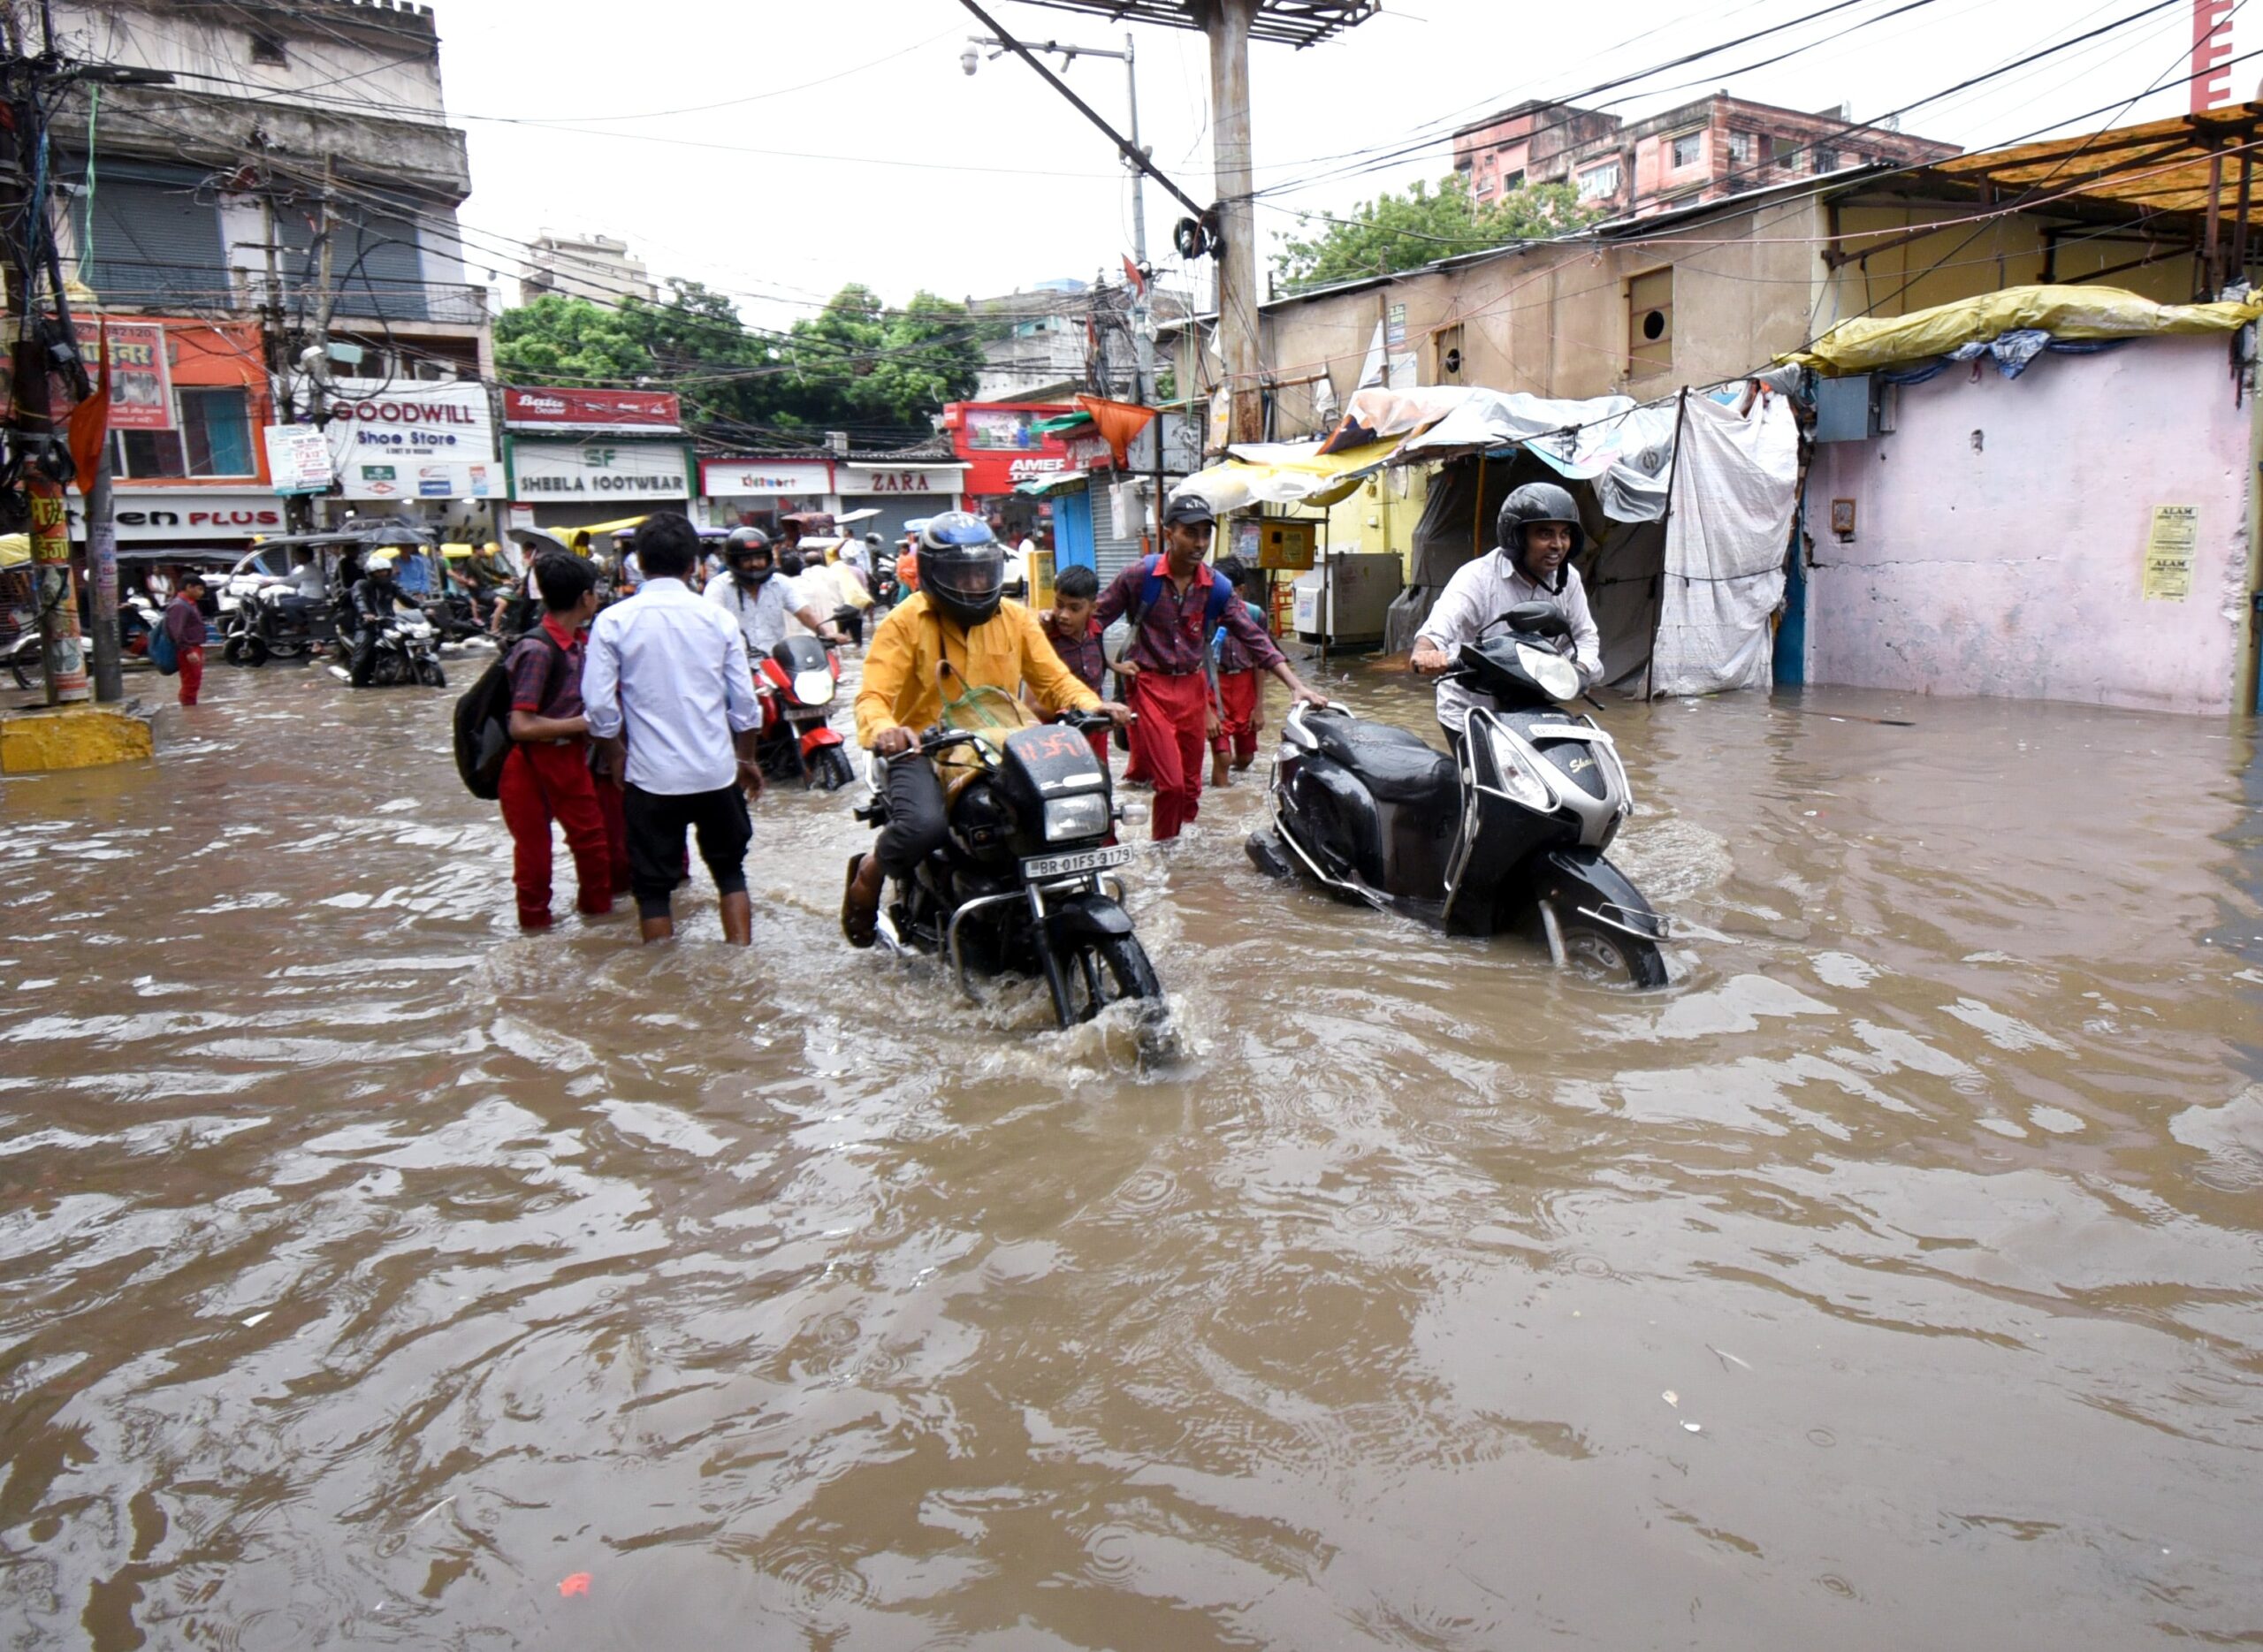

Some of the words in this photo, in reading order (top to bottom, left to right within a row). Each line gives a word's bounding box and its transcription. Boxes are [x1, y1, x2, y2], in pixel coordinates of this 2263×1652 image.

[331, 400, 475, 424] GOODWILL
[357, 431, 402, 445] Shoe
[410, 431, 456, 445] Store
[583, 449, 616, 467] SF
[522, 476, 584, 491] SHEELA
[872, 473, 929, 491] ZARA
[189, 511, 279, 526] PLUS
[1040, 860, 1057, 874] BR
[1062, 855, 1094, 871] 01FS
[1099, 849, 1130, 864] 3179
